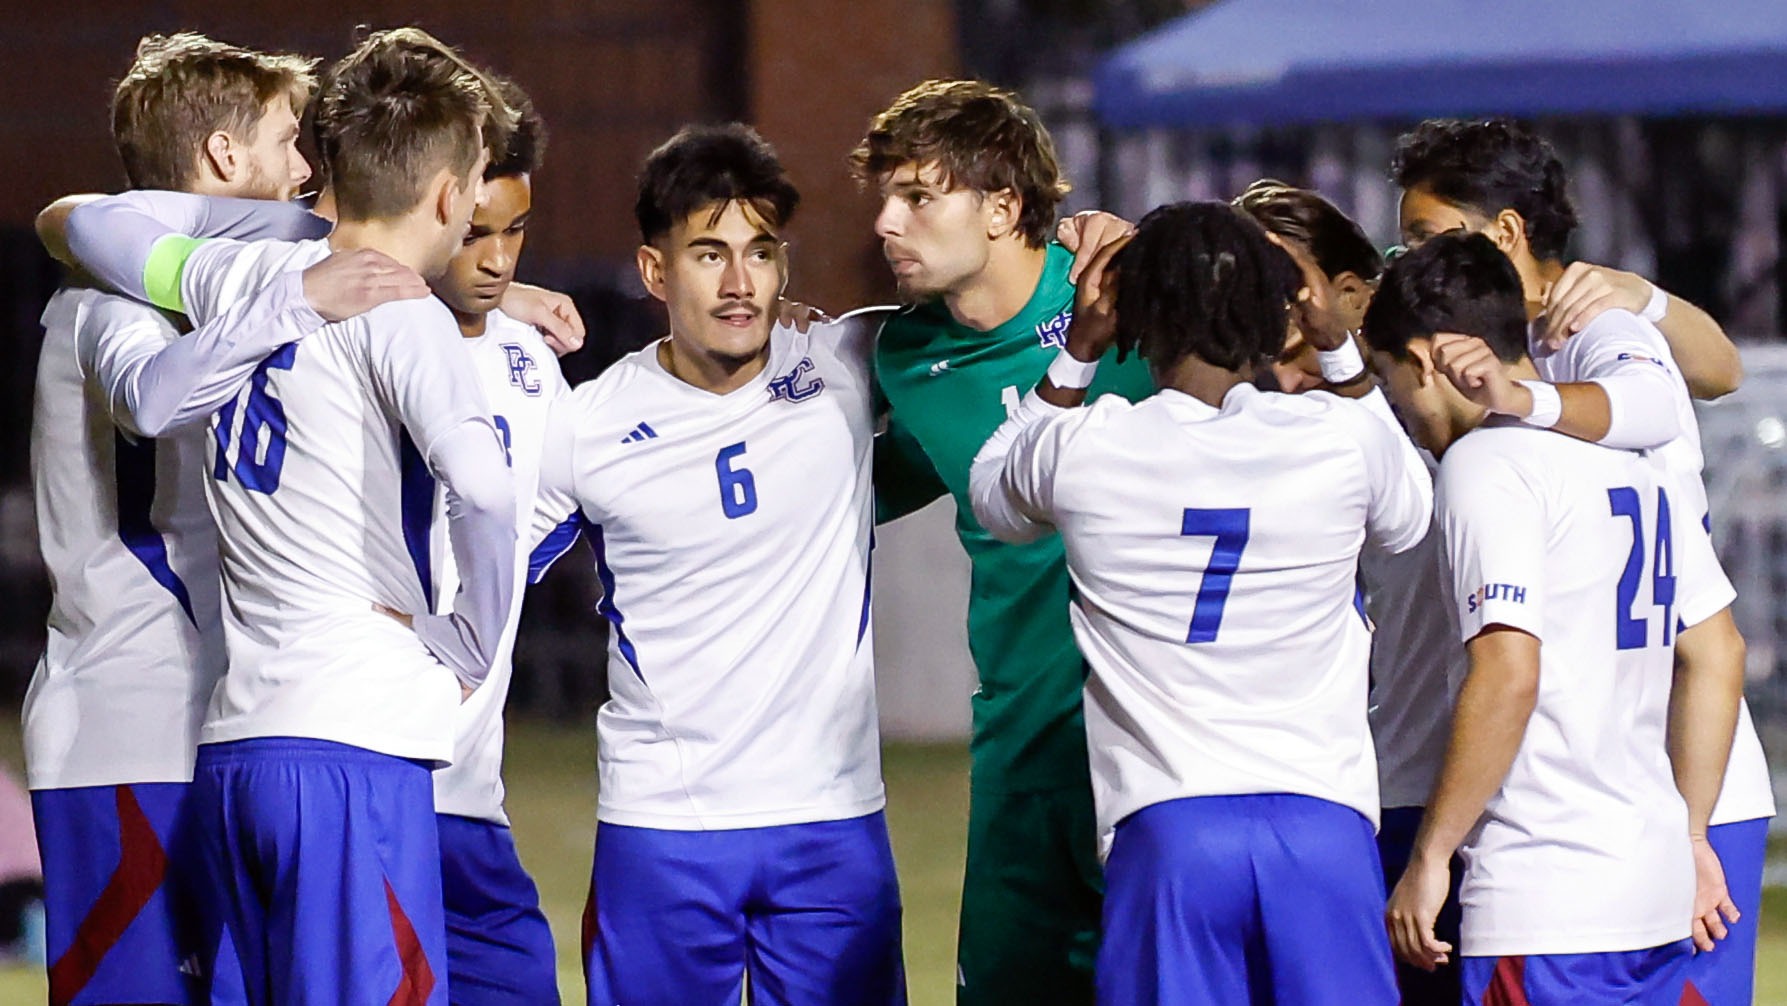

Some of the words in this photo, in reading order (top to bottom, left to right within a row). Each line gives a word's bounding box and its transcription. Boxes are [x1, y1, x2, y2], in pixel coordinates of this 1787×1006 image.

[715, 441, 758, 519] 6
[1180, 507, 1251, 643] 7
[1607, 486, 1676, 650] 24
